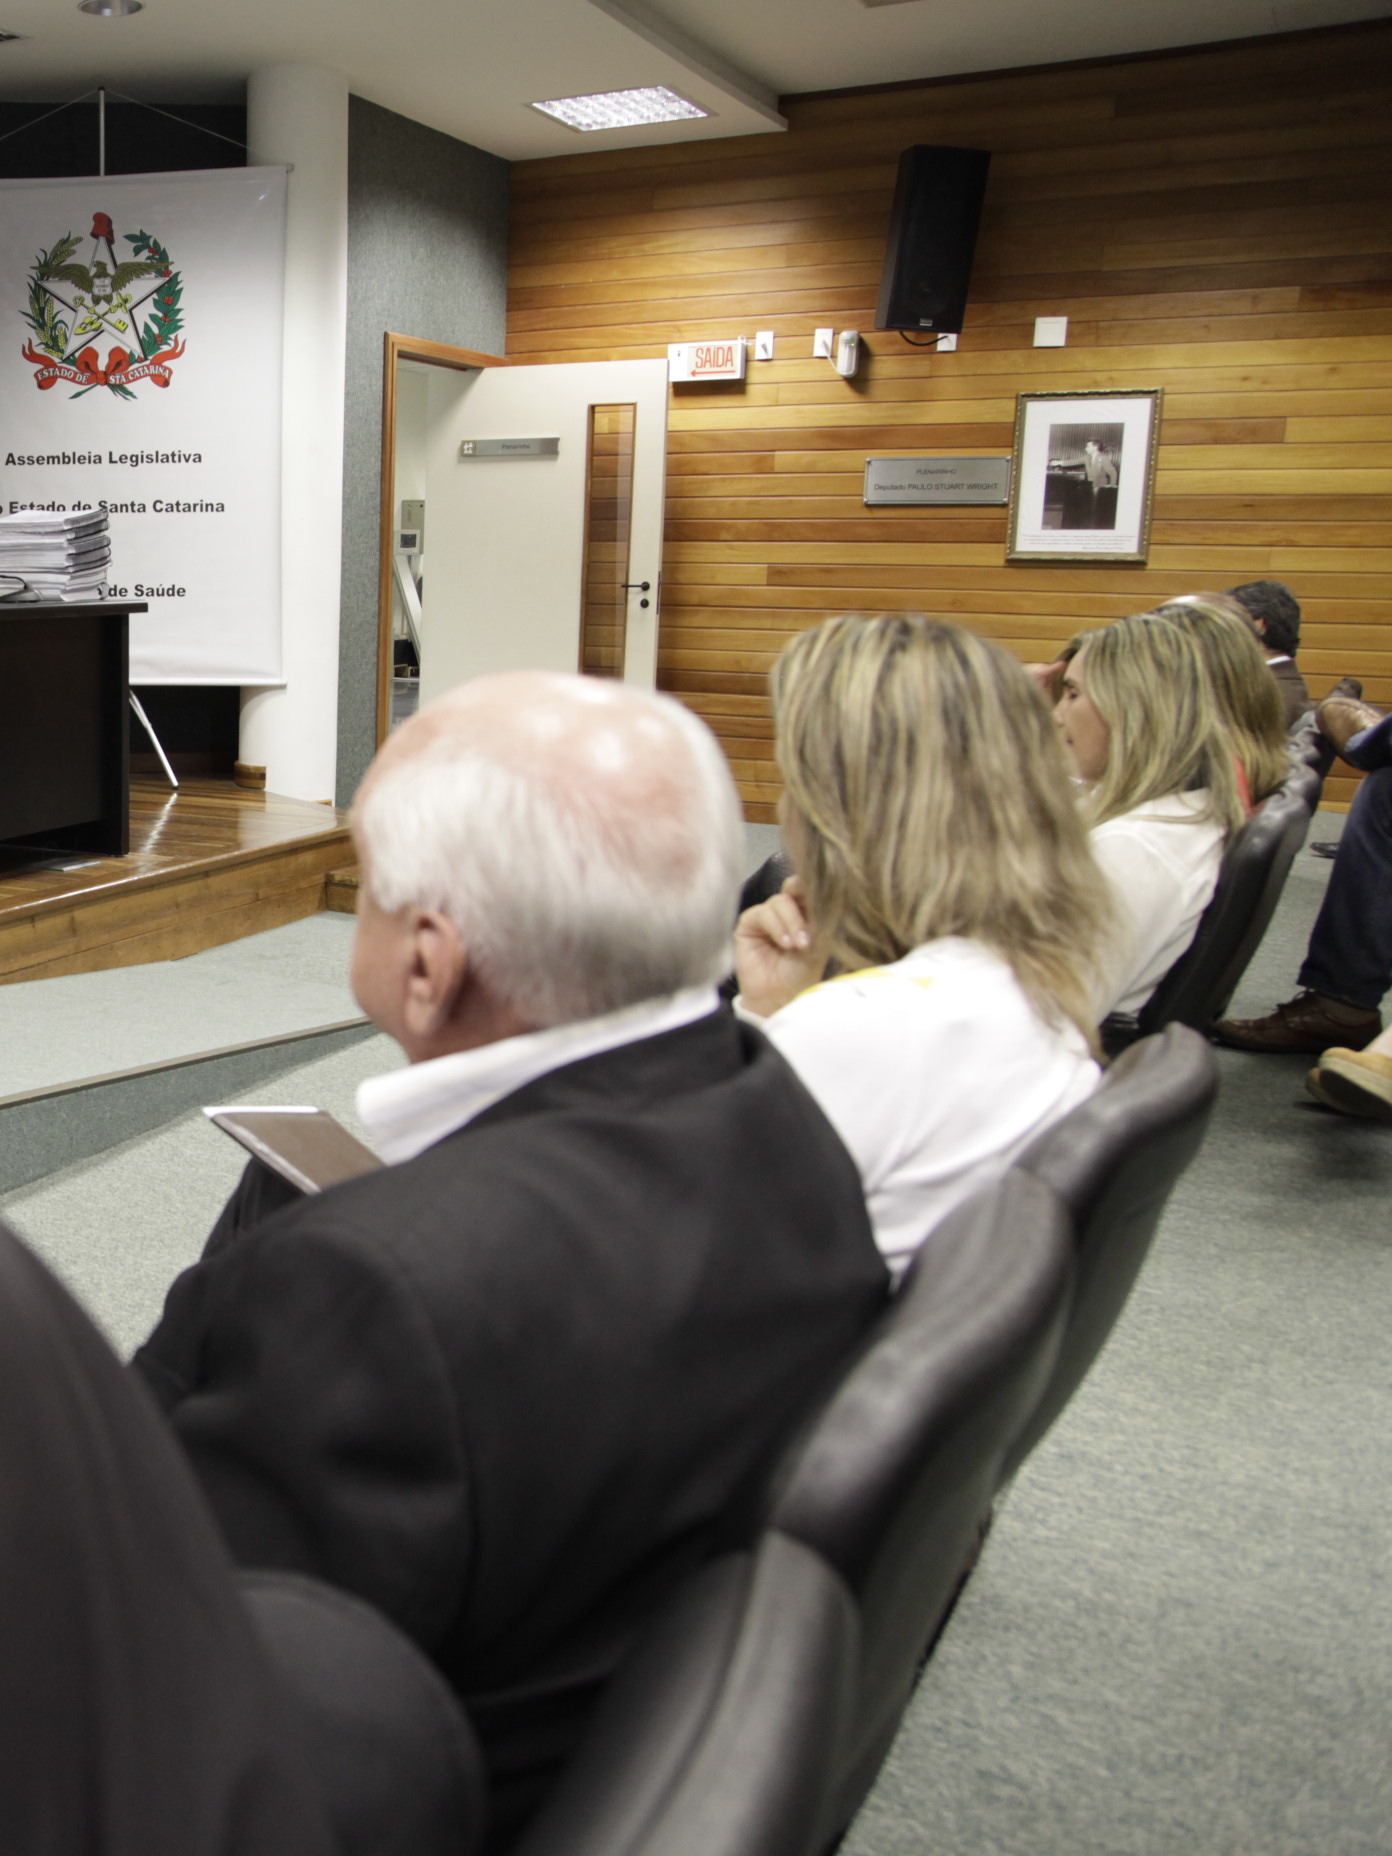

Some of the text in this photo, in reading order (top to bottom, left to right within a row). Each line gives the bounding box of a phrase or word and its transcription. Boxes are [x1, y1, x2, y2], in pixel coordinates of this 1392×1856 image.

[37, 367, 75, 381] ESTADO
[75, 372, 89, 384] DE
[128, 364, 170, 380] CATARINA
[5, 450, 202, 467] Assembleia Legislativa
[874, 482, 999, 491] Deputado PAULO STUART WRIGHT
[98, 500, 146, 513] Santa
[152, 500, 225, 513] Catarina
[108, 584, 128, 597] de
[134, 583, 186, 597] Saúde
